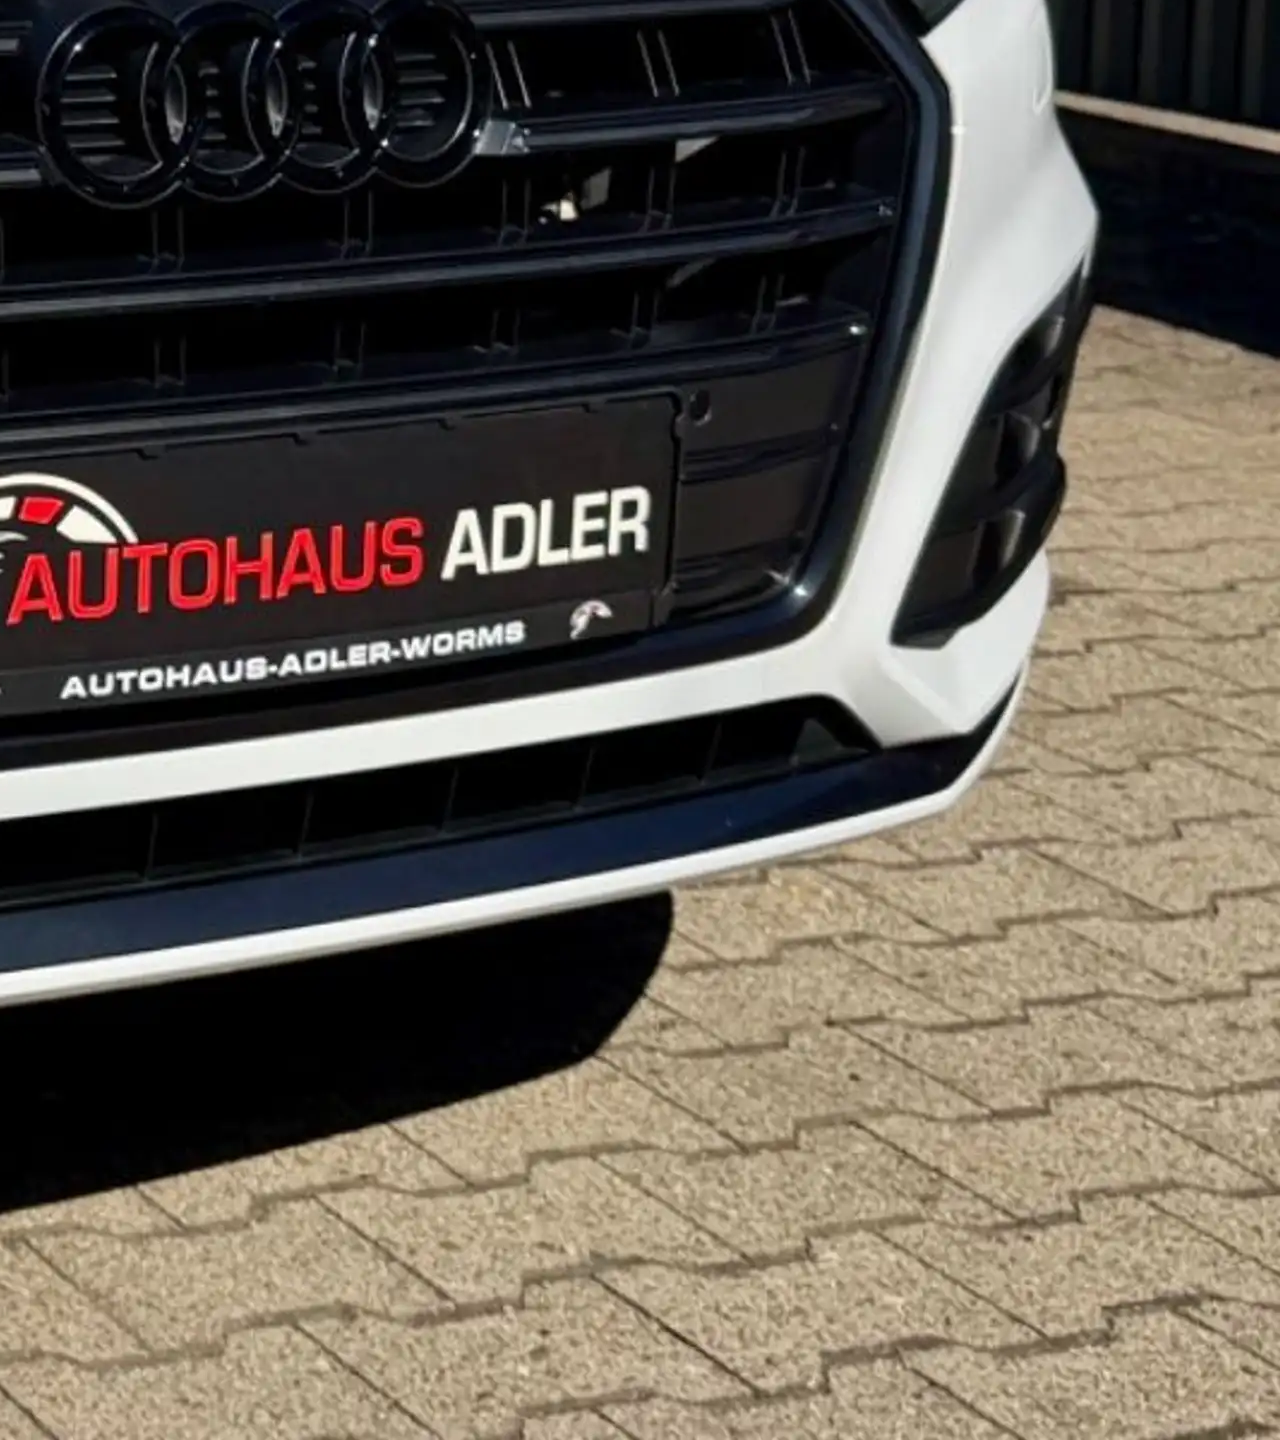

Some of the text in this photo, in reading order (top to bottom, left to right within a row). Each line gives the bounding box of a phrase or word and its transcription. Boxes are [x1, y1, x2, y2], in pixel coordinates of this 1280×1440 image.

[6, 484, 651, 625] AUTOHAUS ADLER
[59, 620, 527, 699] AUTOHAUS-ADLER-WORMS
